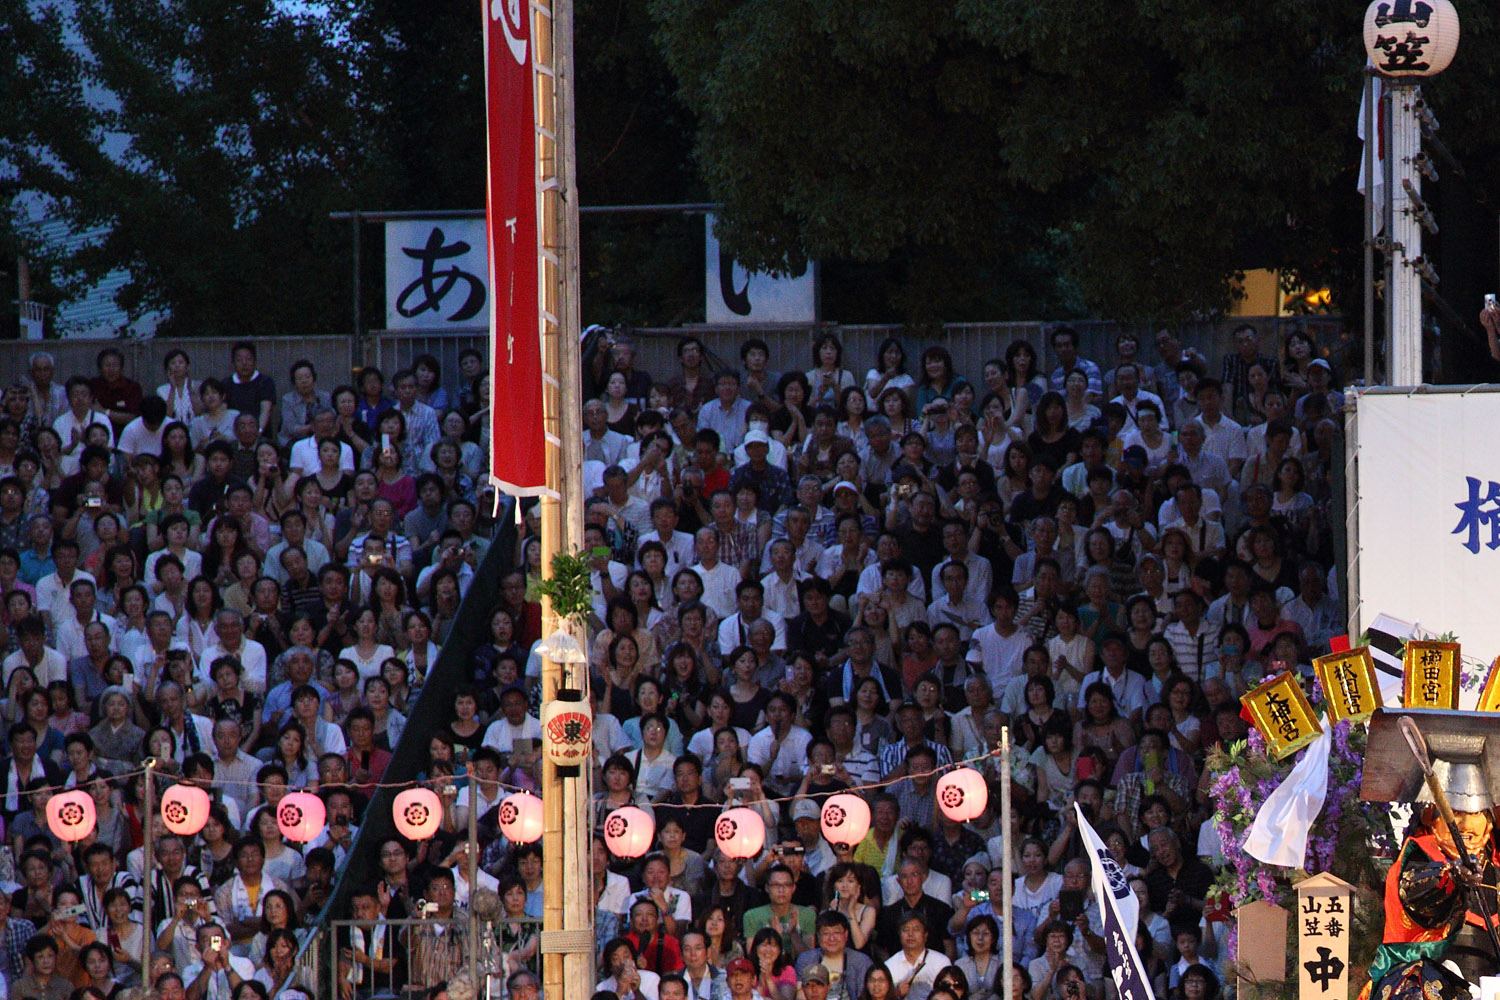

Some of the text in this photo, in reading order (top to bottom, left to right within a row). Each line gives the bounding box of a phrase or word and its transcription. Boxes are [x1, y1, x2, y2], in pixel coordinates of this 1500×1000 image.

[1374, 0, 1433, 71] 山笠
[395, 227, 487, 322] あ
[1420, 650, 1442, 703] 櫛田宮
[1265, 691, 1300, 742] 大神宮
